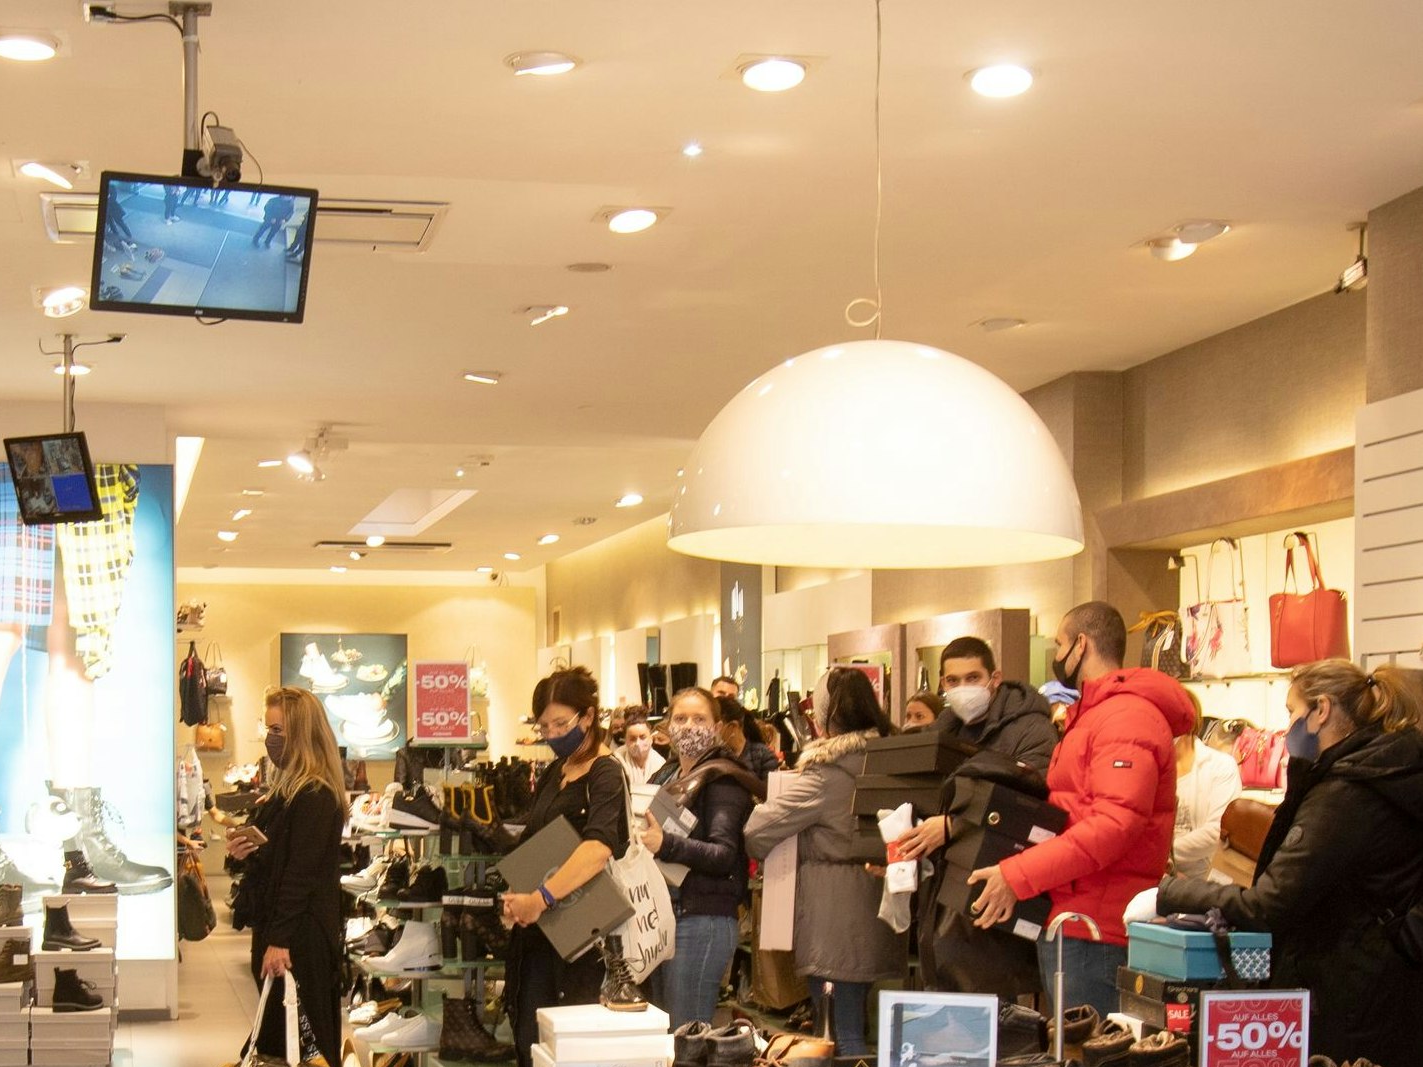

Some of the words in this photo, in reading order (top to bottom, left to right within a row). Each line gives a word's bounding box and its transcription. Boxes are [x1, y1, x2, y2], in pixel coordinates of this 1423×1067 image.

[1168, 1009, 1189, 1020] SALE
[1232, 1014, 1250, 1022] AUF
[1251, 1013, 1278, 1021] ALLES
[1231, 1050, 1248, 1059] AUF
[1249, 1049, 1278, 1058] ALLES
